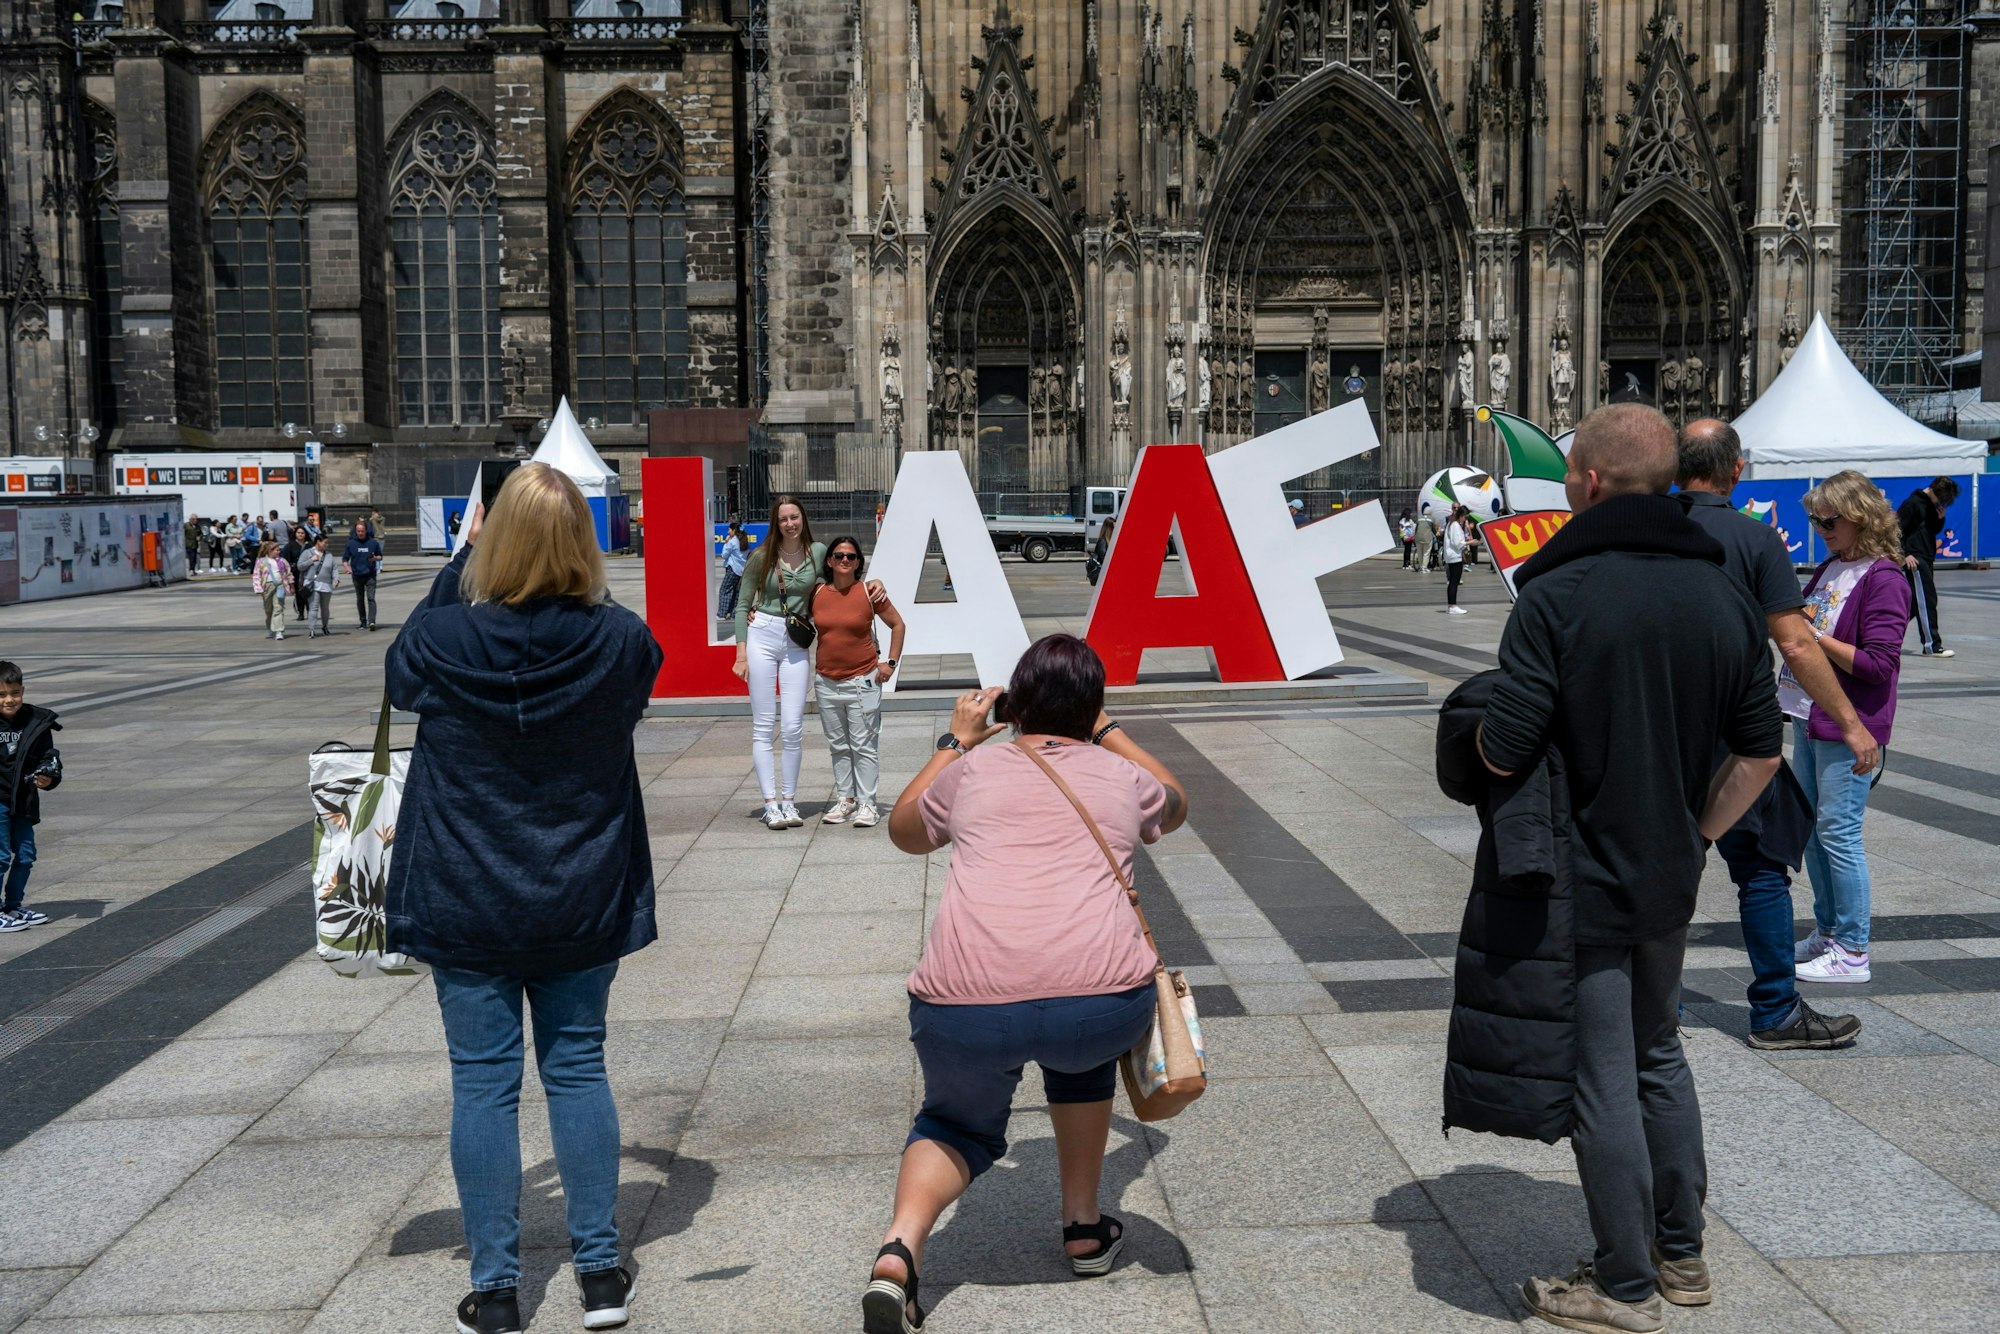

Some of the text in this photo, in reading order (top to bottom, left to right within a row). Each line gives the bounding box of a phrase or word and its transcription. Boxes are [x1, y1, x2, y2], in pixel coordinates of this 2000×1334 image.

[158, 470, 173, 483] WC
[212, 469, 228, 482] WC
[641, 398, 1396, 699] LAAF
